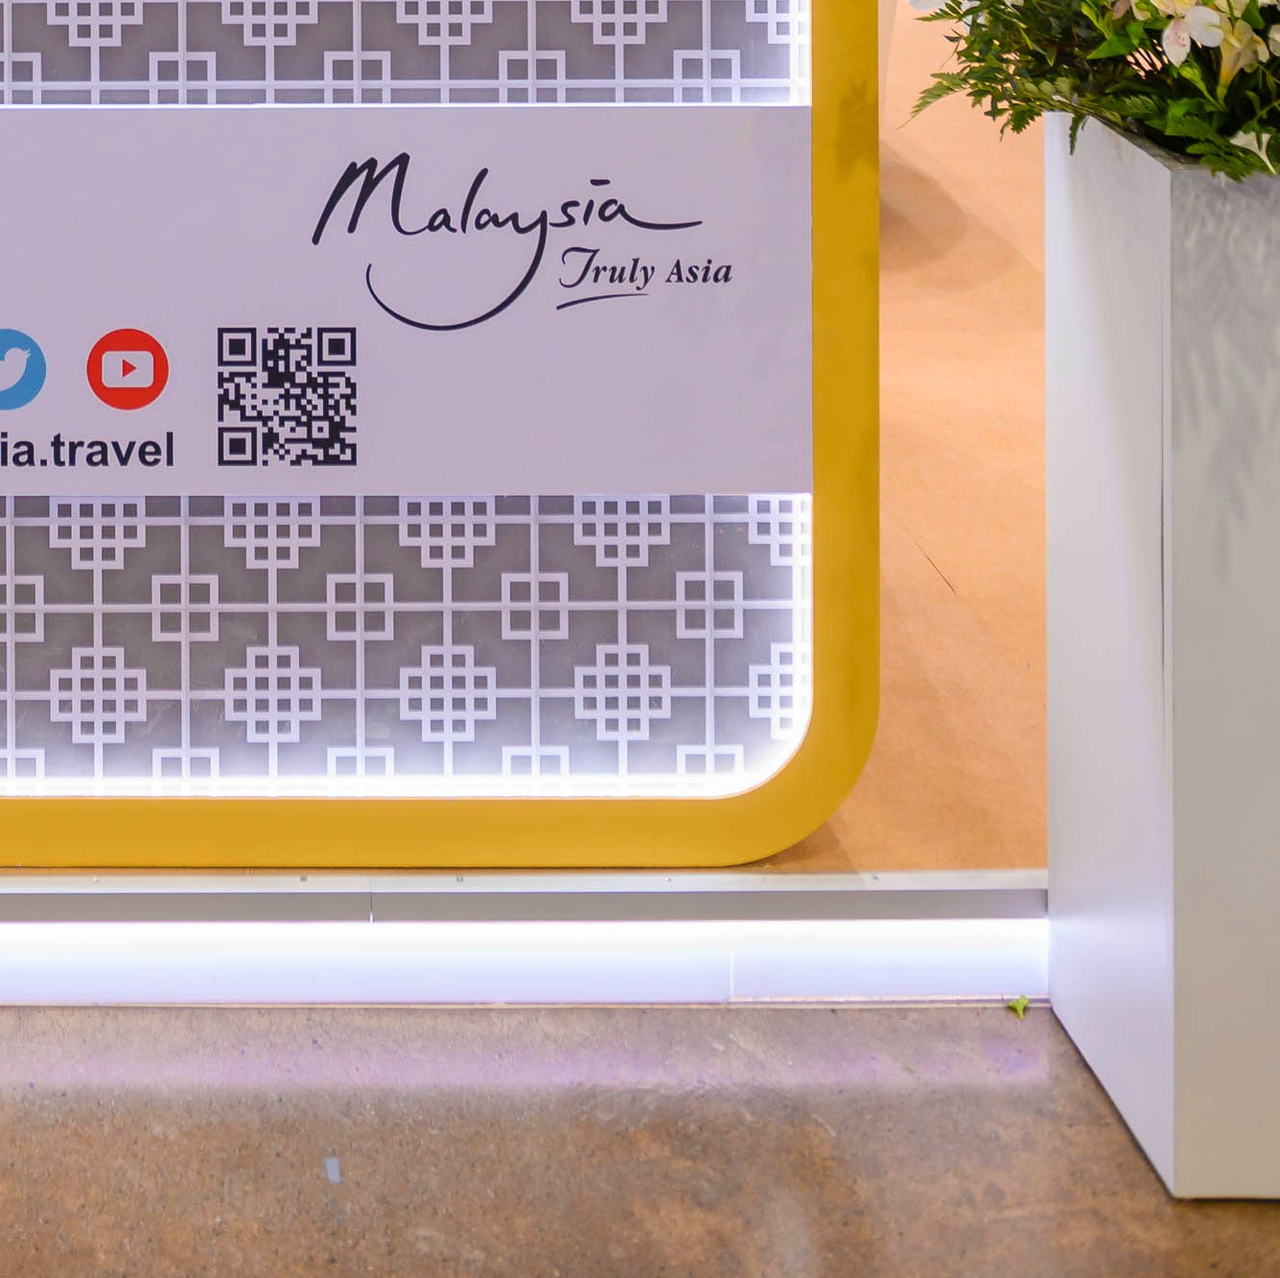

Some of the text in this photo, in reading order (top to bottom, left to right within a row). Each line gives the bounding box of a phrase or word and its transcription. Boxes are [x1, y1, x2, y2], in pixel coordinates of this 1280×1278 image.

[312, 152, 702, 331] Malaysia
[559, 246, 733, 290] Truly Asia
